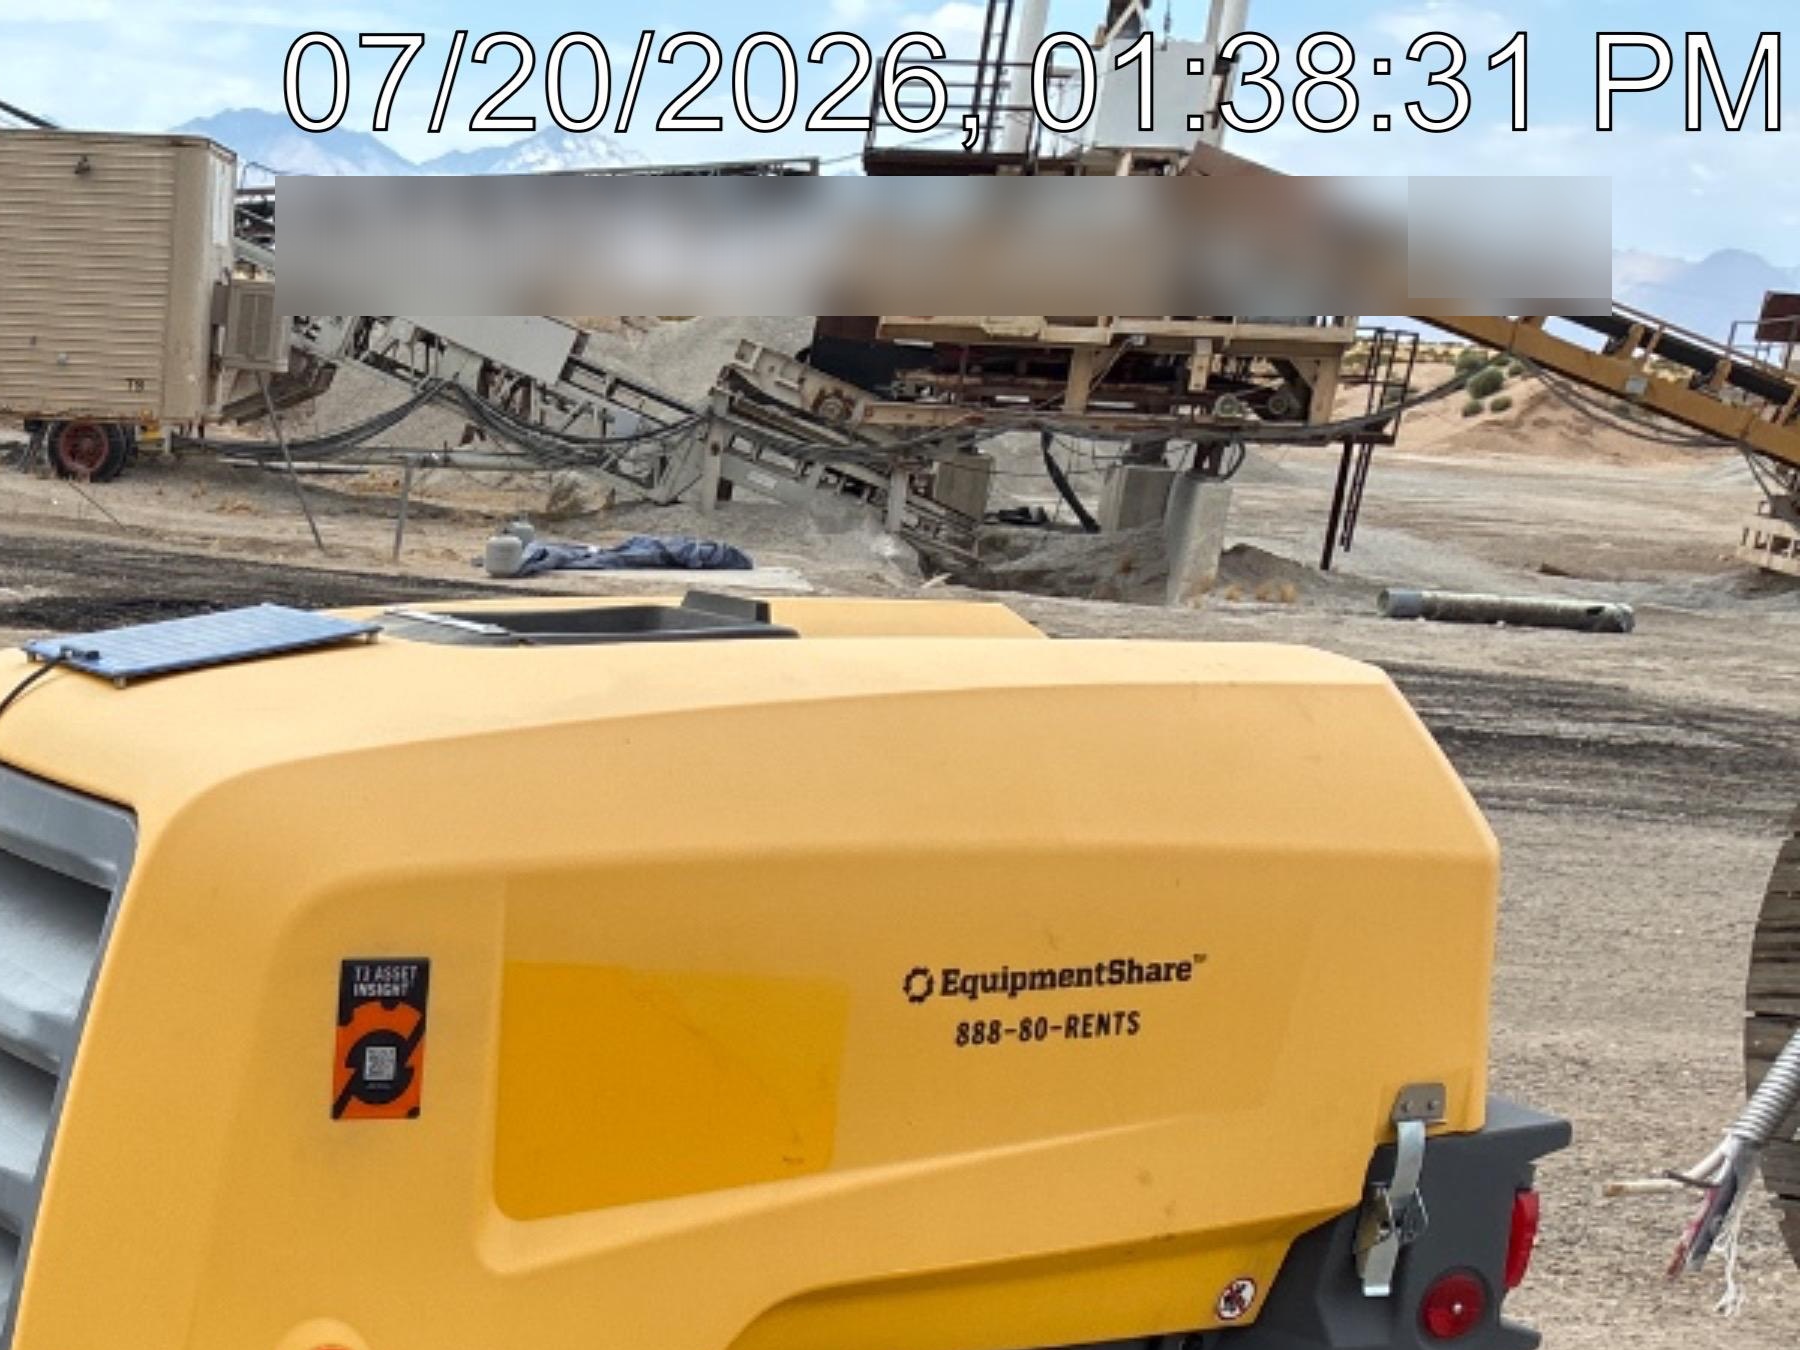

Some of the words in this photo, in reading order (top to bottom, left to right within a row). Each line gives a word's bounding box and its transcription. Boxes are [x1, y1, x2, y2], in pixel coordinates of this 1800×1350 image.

[374, 965, 418, 983] ASSET
[940, 957, 1193, 1001] EquipmentShare
[353, 982, 408, 997] INSIGHT
[955, 1010, 1142, 1047] 888-80-RENTS
